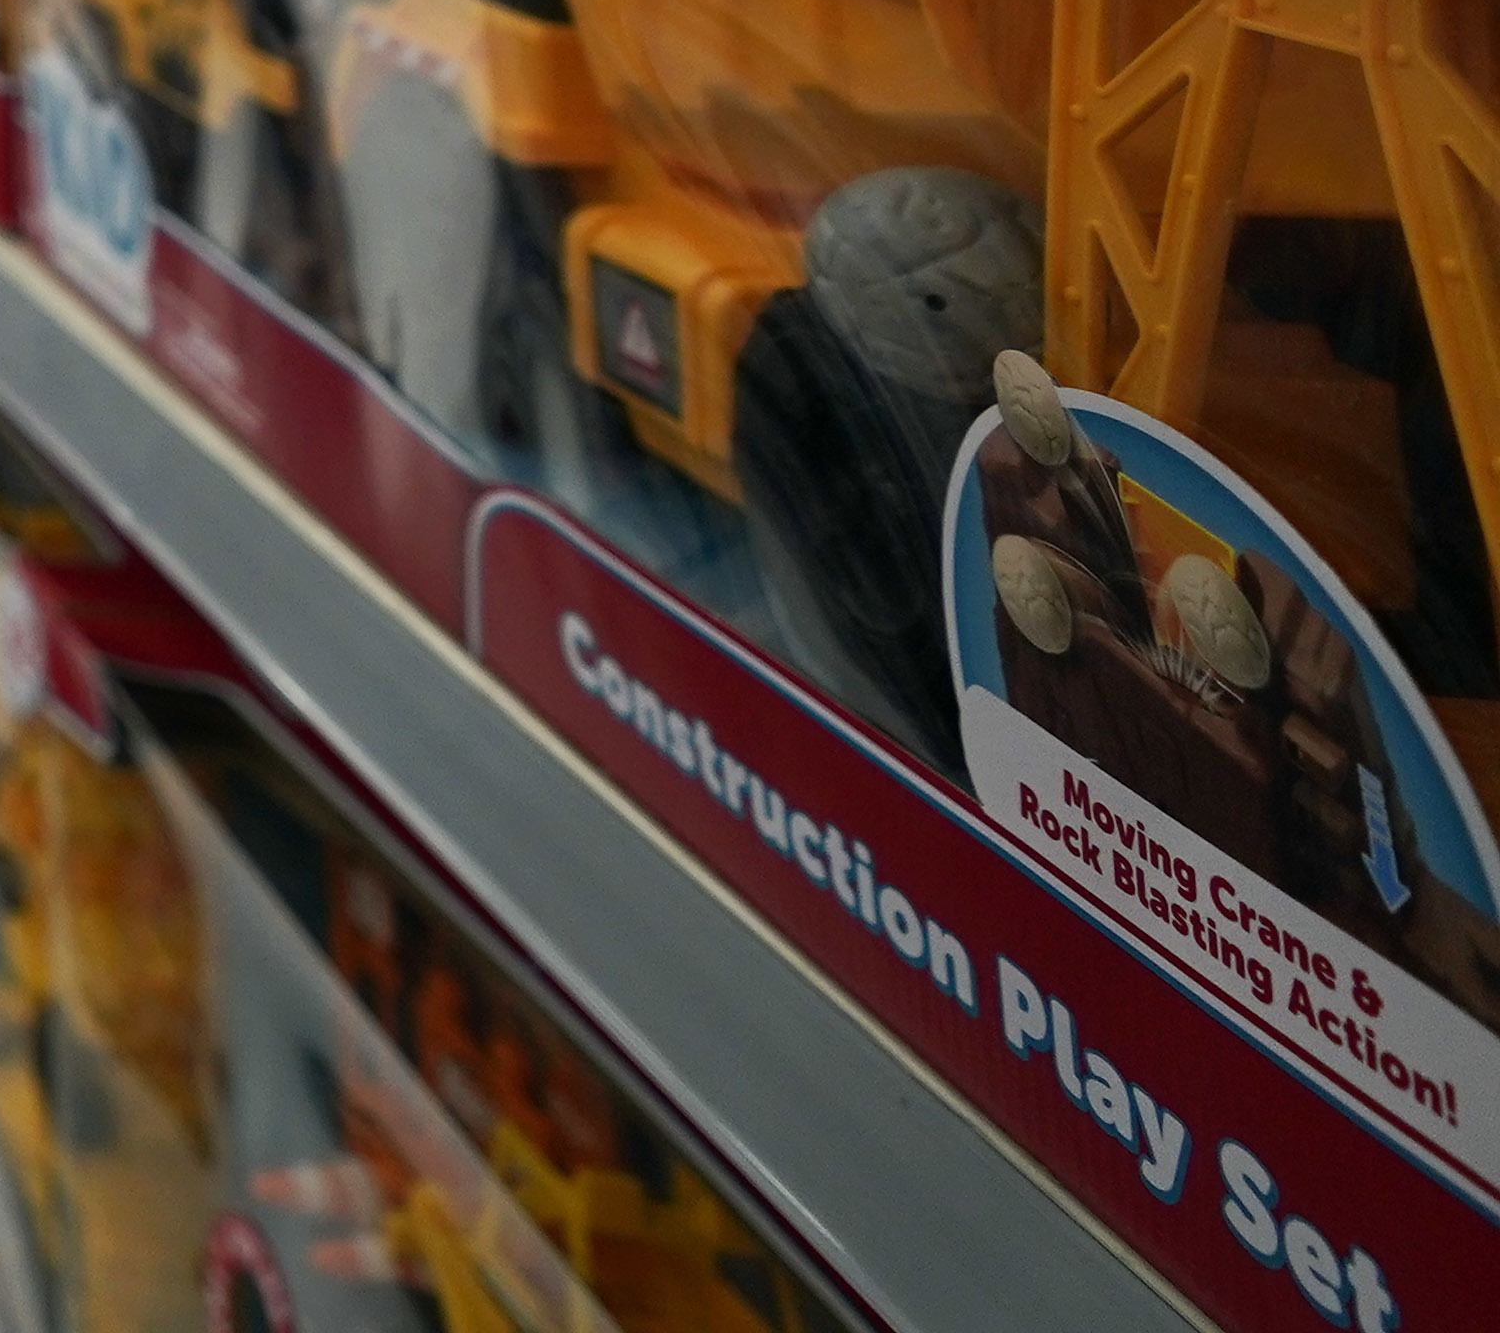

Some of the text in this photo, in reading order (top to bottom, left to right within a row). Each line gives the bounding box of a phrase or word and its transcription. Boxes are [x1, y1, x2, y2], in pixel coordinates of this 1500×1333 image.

[559, 611, 1400, 1333] Construction Play Set
[1019, 781, 1458, 1129] Rock Blasting Action!
[1062, 768, 1385, 1019] Moving Crane &
